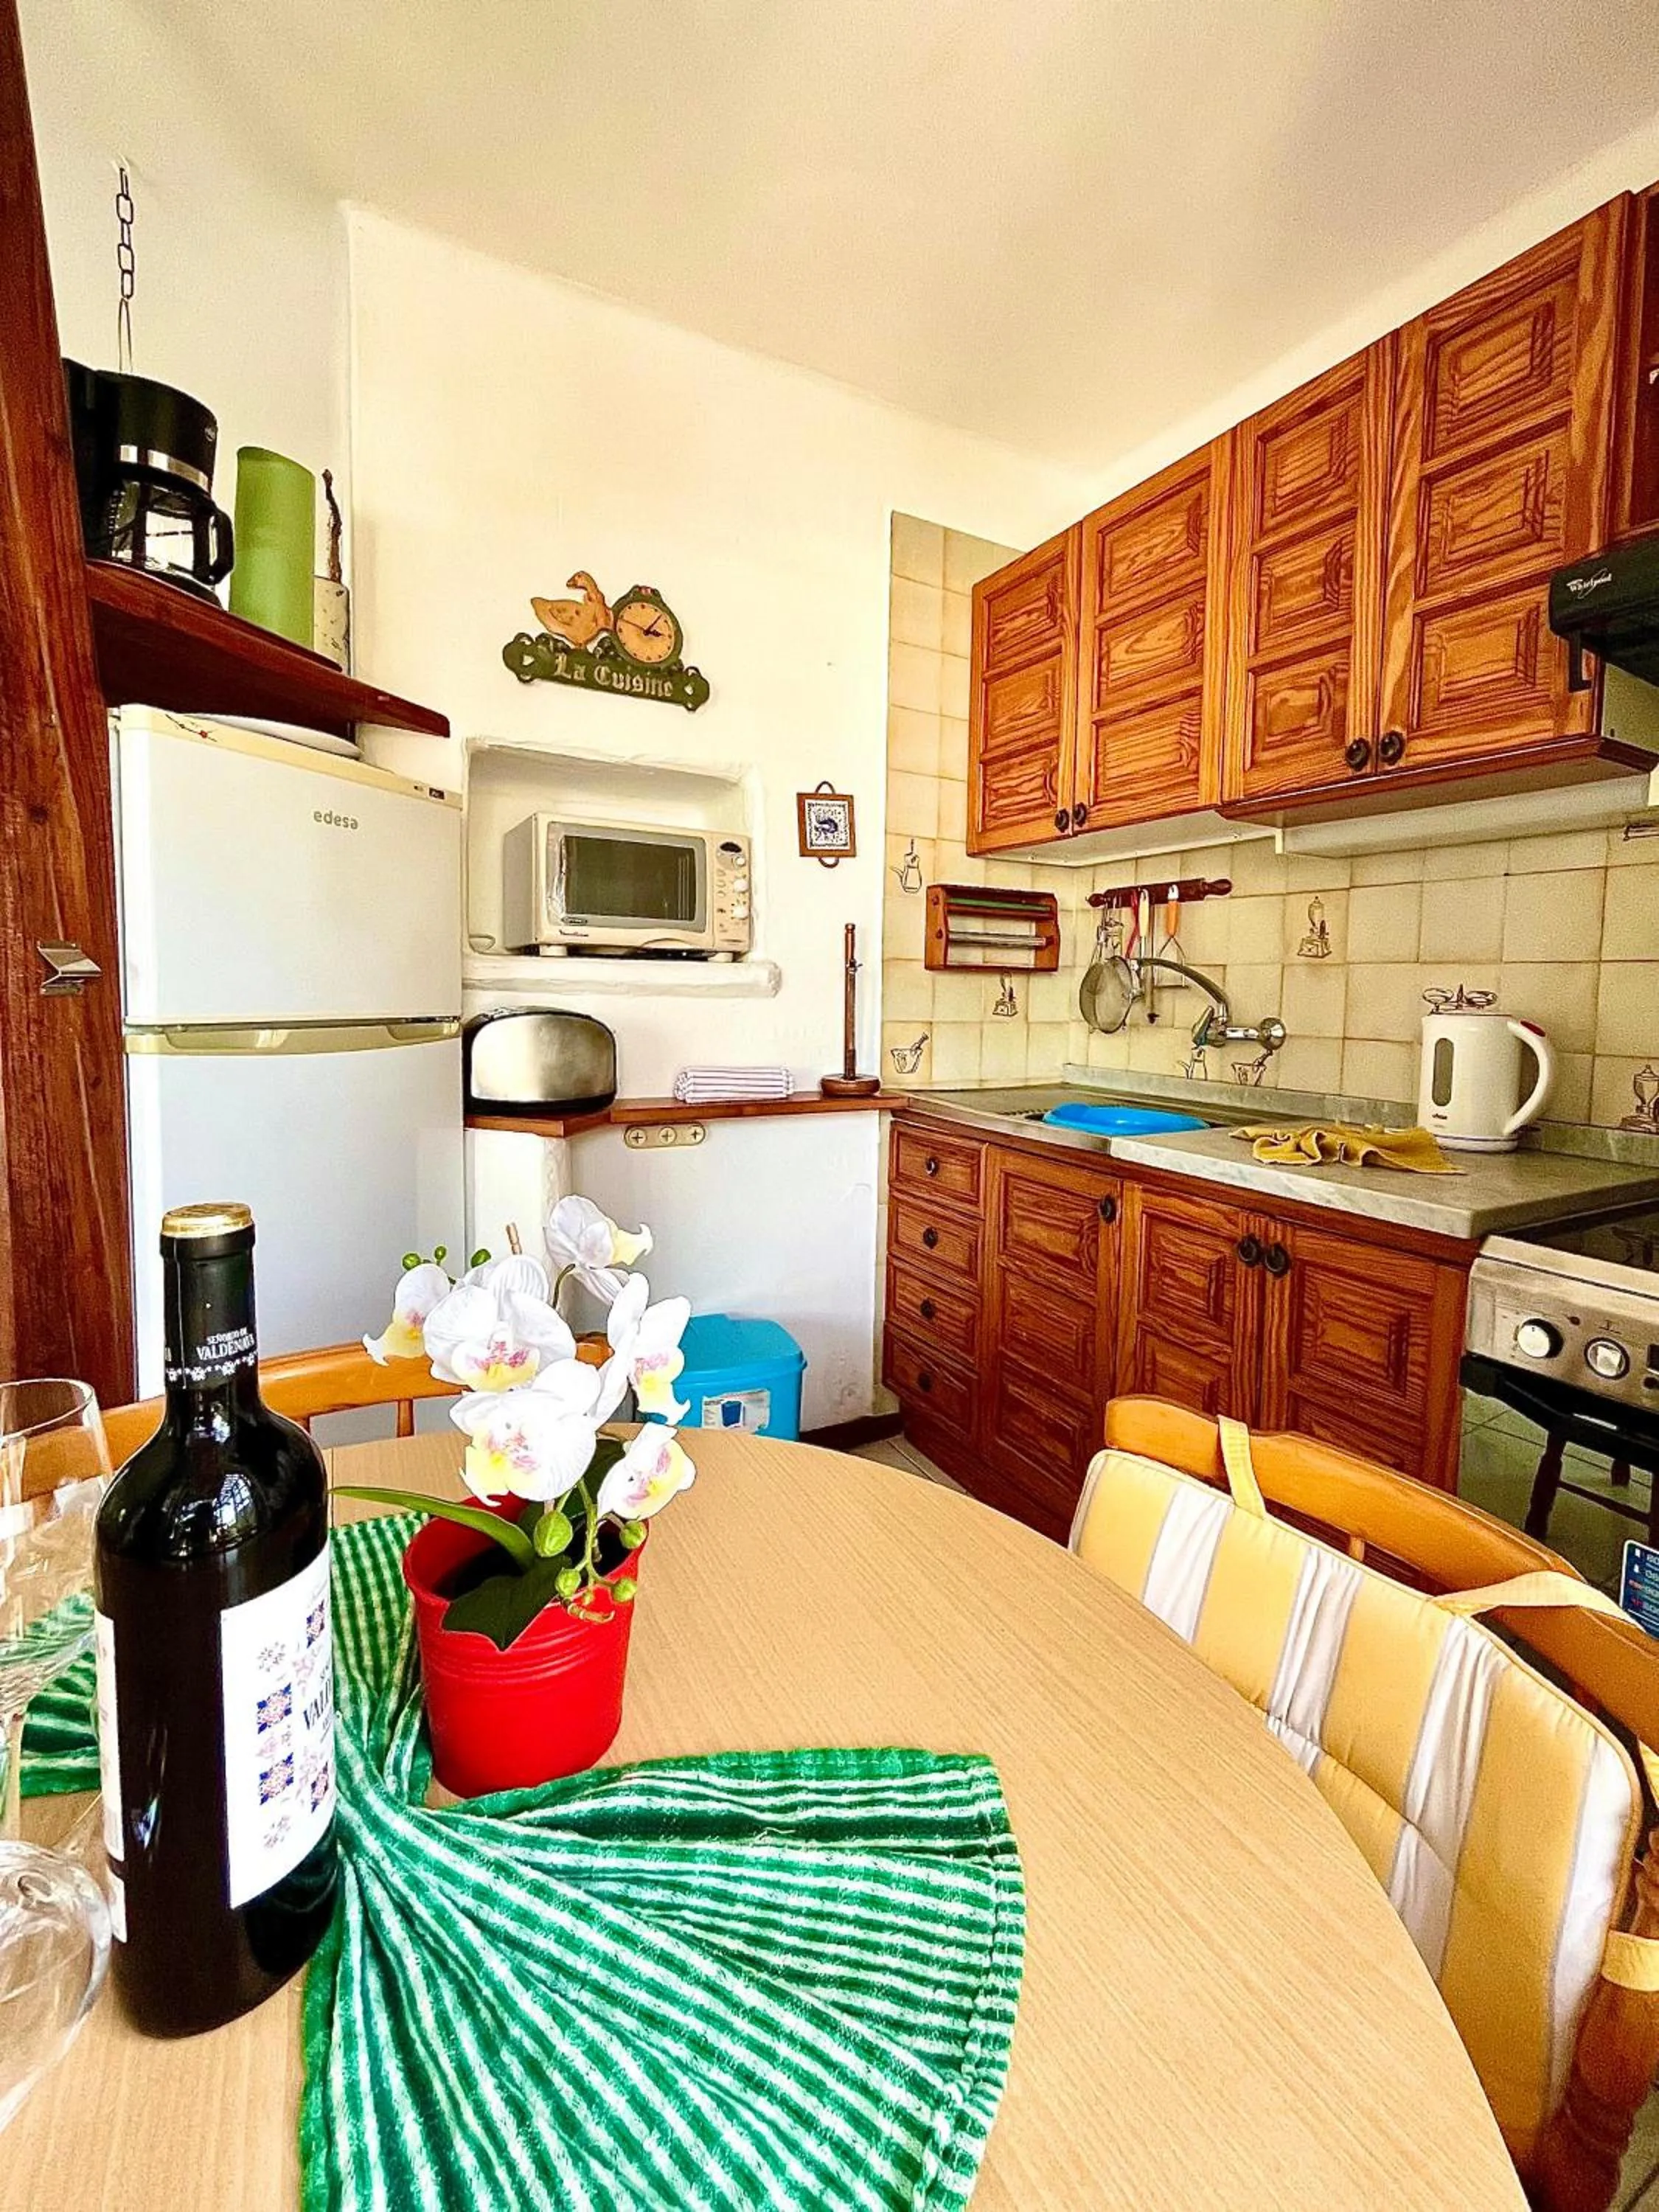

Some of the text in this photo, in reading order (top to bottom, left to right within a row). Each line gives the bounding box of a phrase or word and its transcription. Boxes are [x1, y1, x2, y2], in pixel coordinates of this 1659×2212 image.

[554, 652, 673, 698] La Cuisine
[313, 810, 359, 830] edesa
